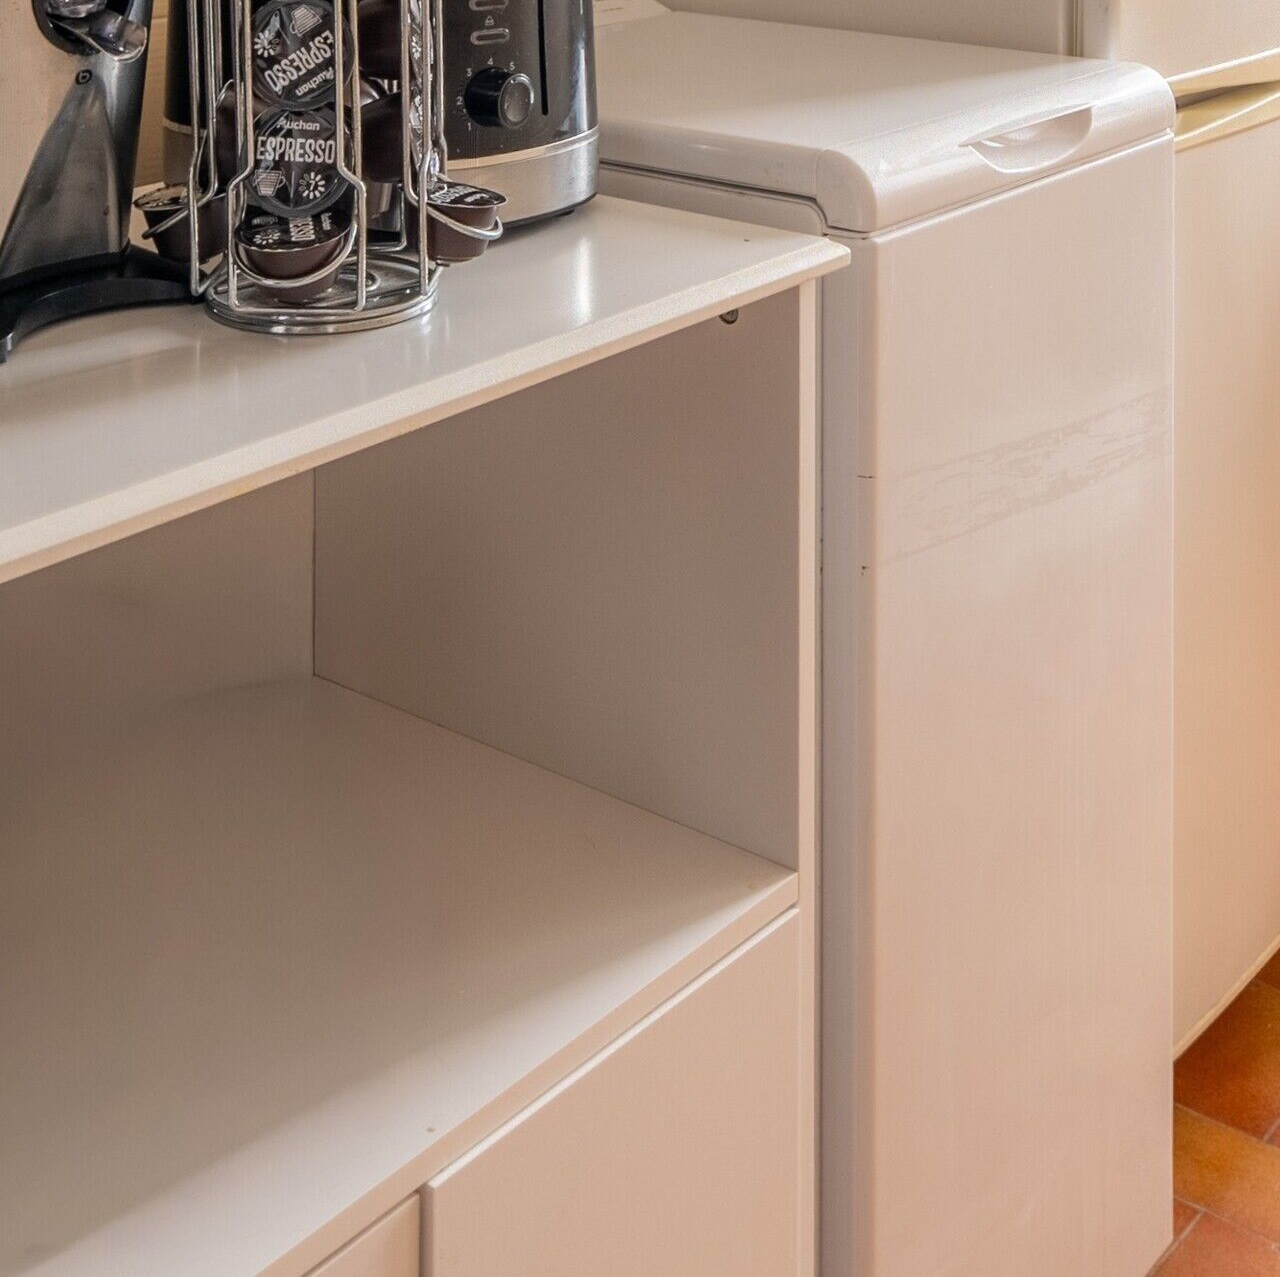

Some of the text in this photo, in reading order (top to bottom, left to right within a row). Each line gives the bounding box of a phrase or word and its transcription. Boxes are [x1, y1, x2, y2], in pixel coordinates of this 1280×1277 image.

[487, 58, 494, 66] 4
[509, 62, 516, 71] 5
[466, 68, 472, 77] 3
[456, 96, 463, 105] 2
[277, 116, 320, 131] Auchan
[467, 122, 472, 131] 1
[256, 136, 336, 164] ESPRESSO
